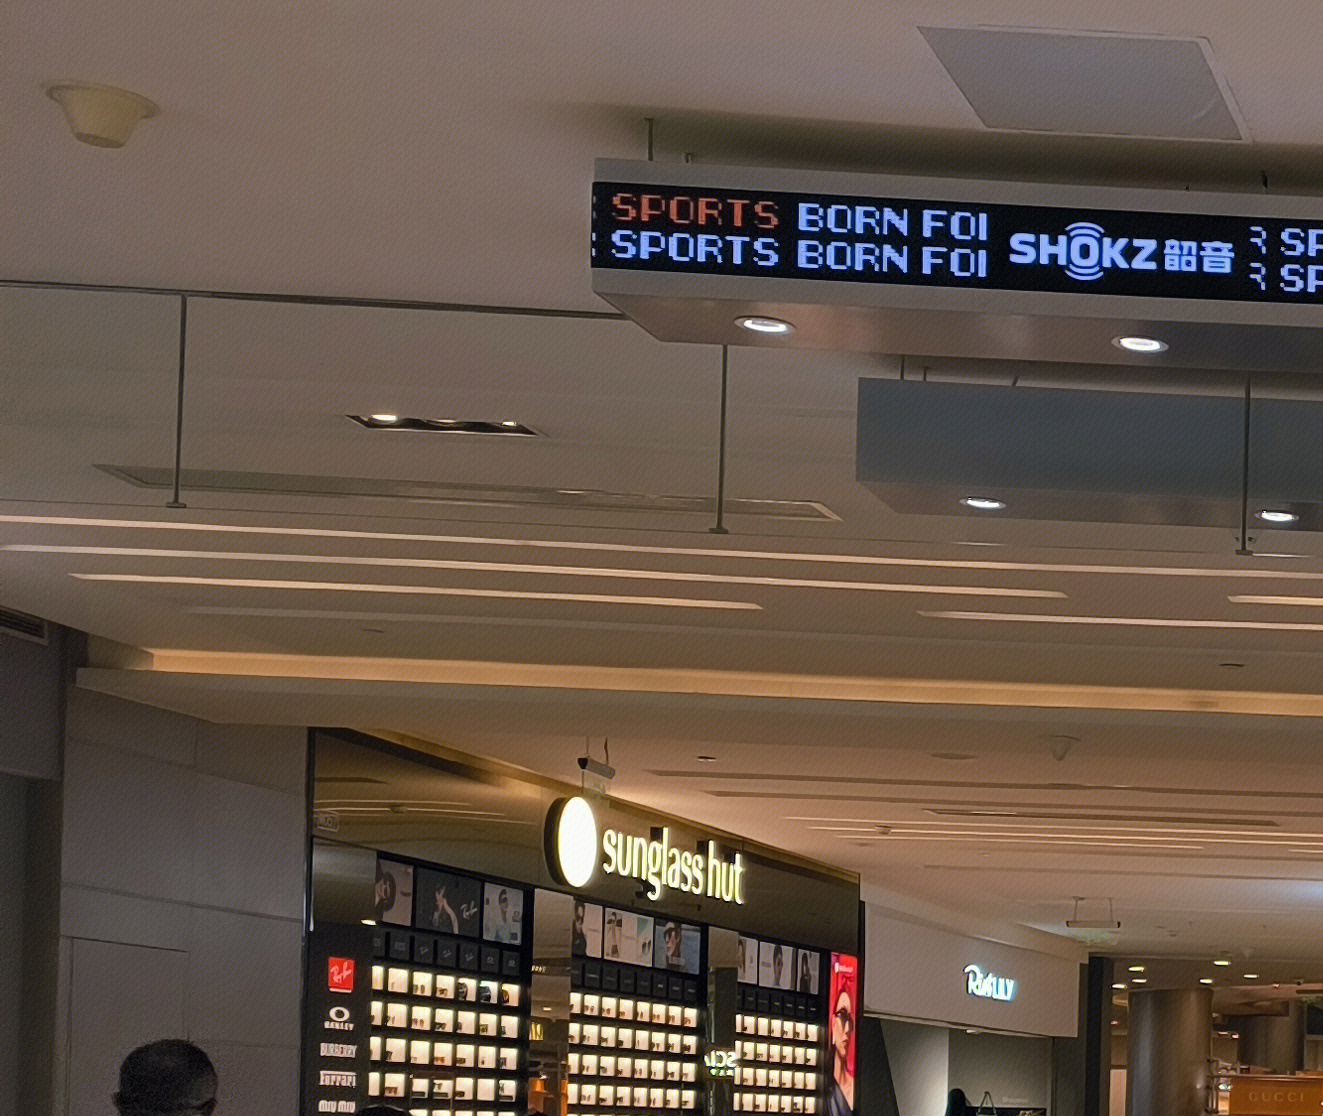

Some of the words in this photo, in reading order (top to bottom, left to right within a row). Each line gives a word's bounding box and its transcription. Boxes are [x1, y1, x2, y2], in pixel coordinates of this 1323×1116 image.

[611, 193, 779, 229] SPORTS
[798, 203, 908, 236] BORN
[611, 229, 779, 266] SPORTS
[797, 240, 908, 273] BORN
[1009, 231, 1158, 271] SHOKZ
[1163, 239, 1235, 273] 韶音
[602, 826, 704, 901] sunglass
[706, 839, 744, 905] hut
